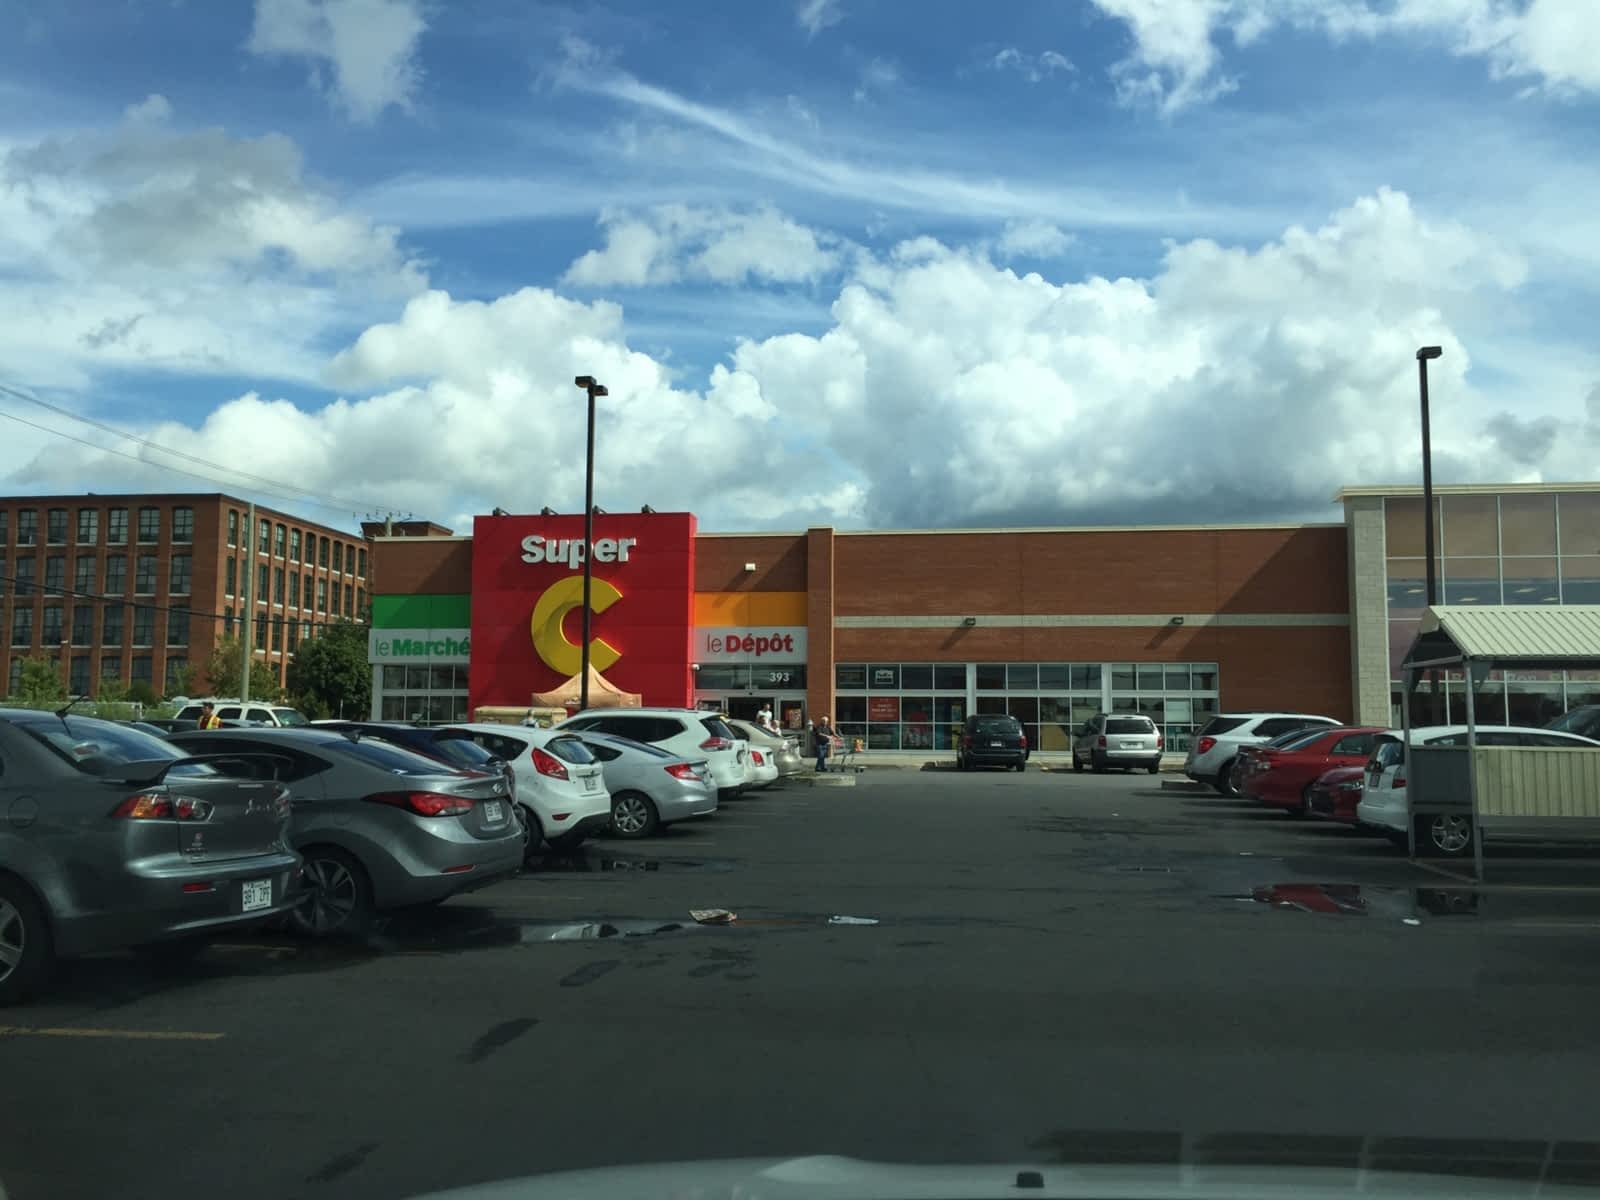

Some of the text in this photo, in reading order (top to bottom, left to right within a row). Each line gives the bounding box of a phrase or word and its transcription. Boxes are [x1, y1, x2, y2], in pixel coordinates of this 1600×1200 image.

[521, 535, 637, 569] Super
[531, 575, 623, 677] C
[375, 636, 470, 656] le Marché
[707, 633, 794, 656] le Dépôt
[769, 672, 790, 682] 393
